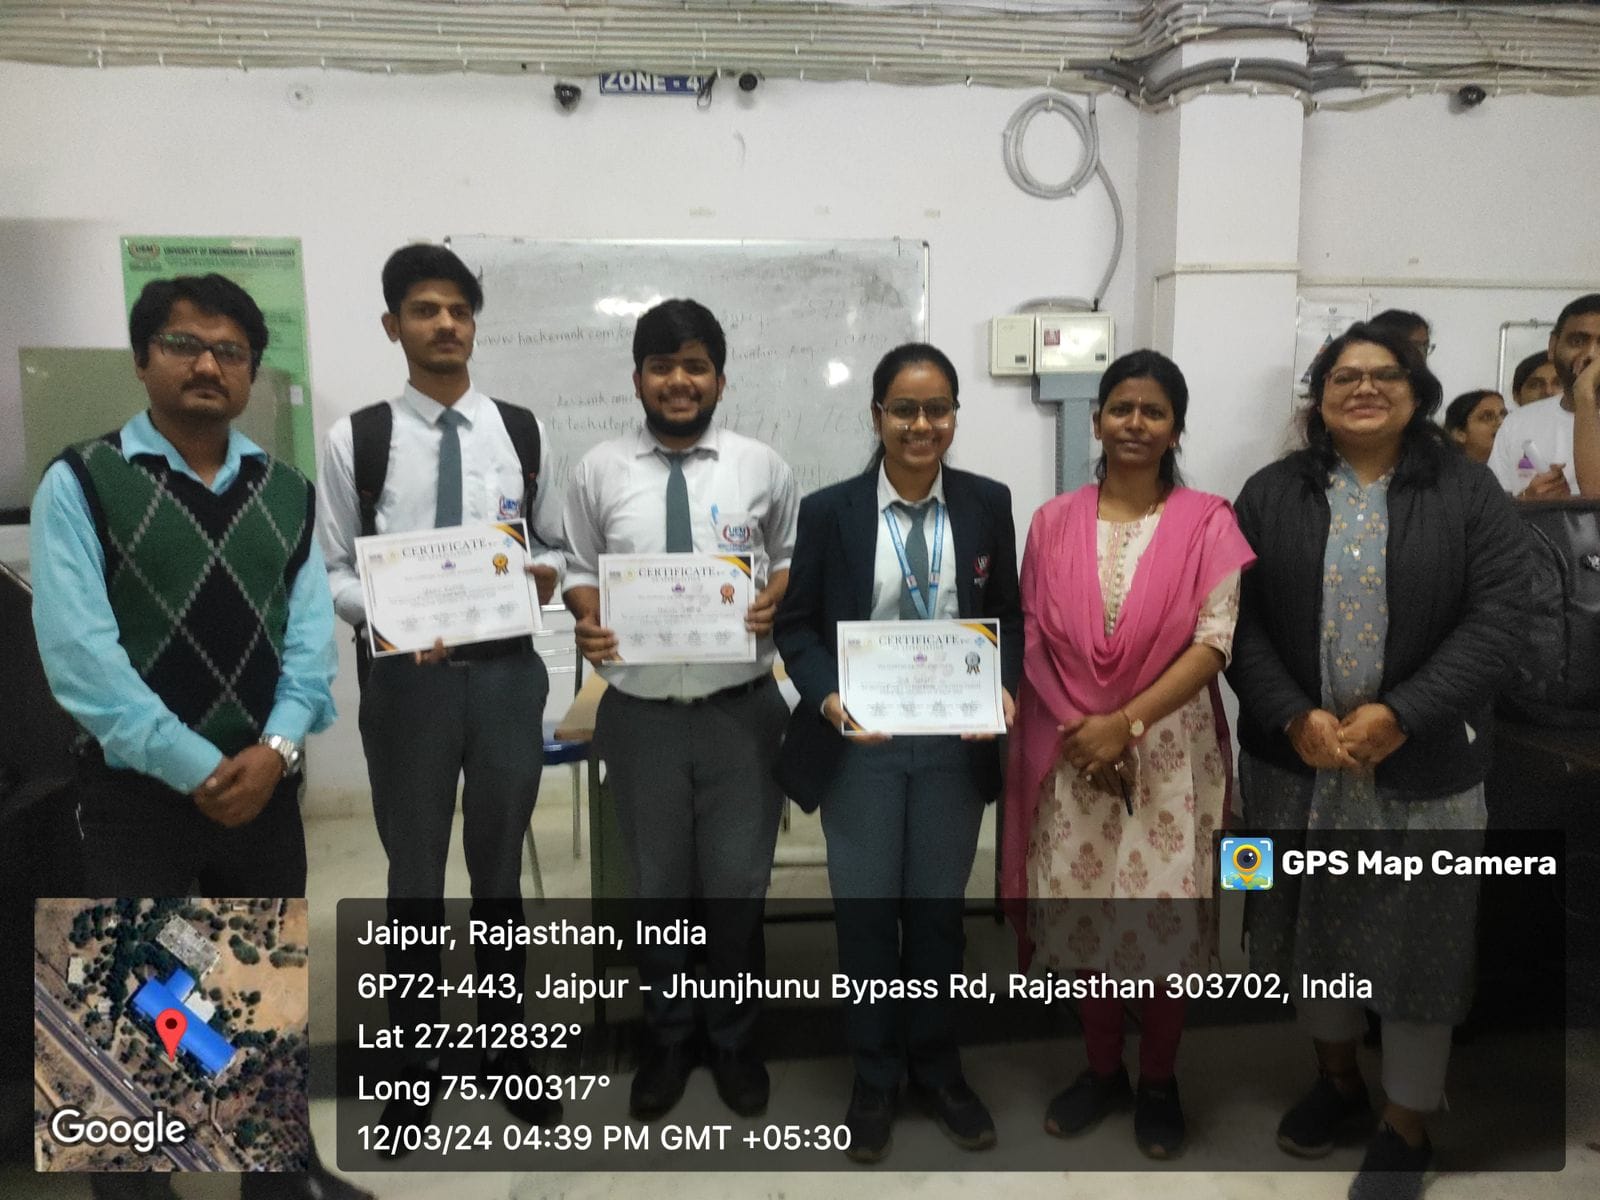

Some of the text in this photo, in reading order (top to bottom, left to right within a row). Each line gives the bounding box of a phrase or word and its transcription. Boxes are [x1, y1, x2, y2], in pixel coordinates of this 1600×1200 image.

[604, 71, 667, 91] ZONE
[686, 76, 699, 91] 4
[163, 247, 198, 256] UNIVERSITY
[255, 248, 295, 257] MANAGEMENT
[402, 537, 488, 558] CERTIFICATE
[639, 566, 717, 577] CERTIFICATE
[878, 634, 961, 646] CERTIFICATE
